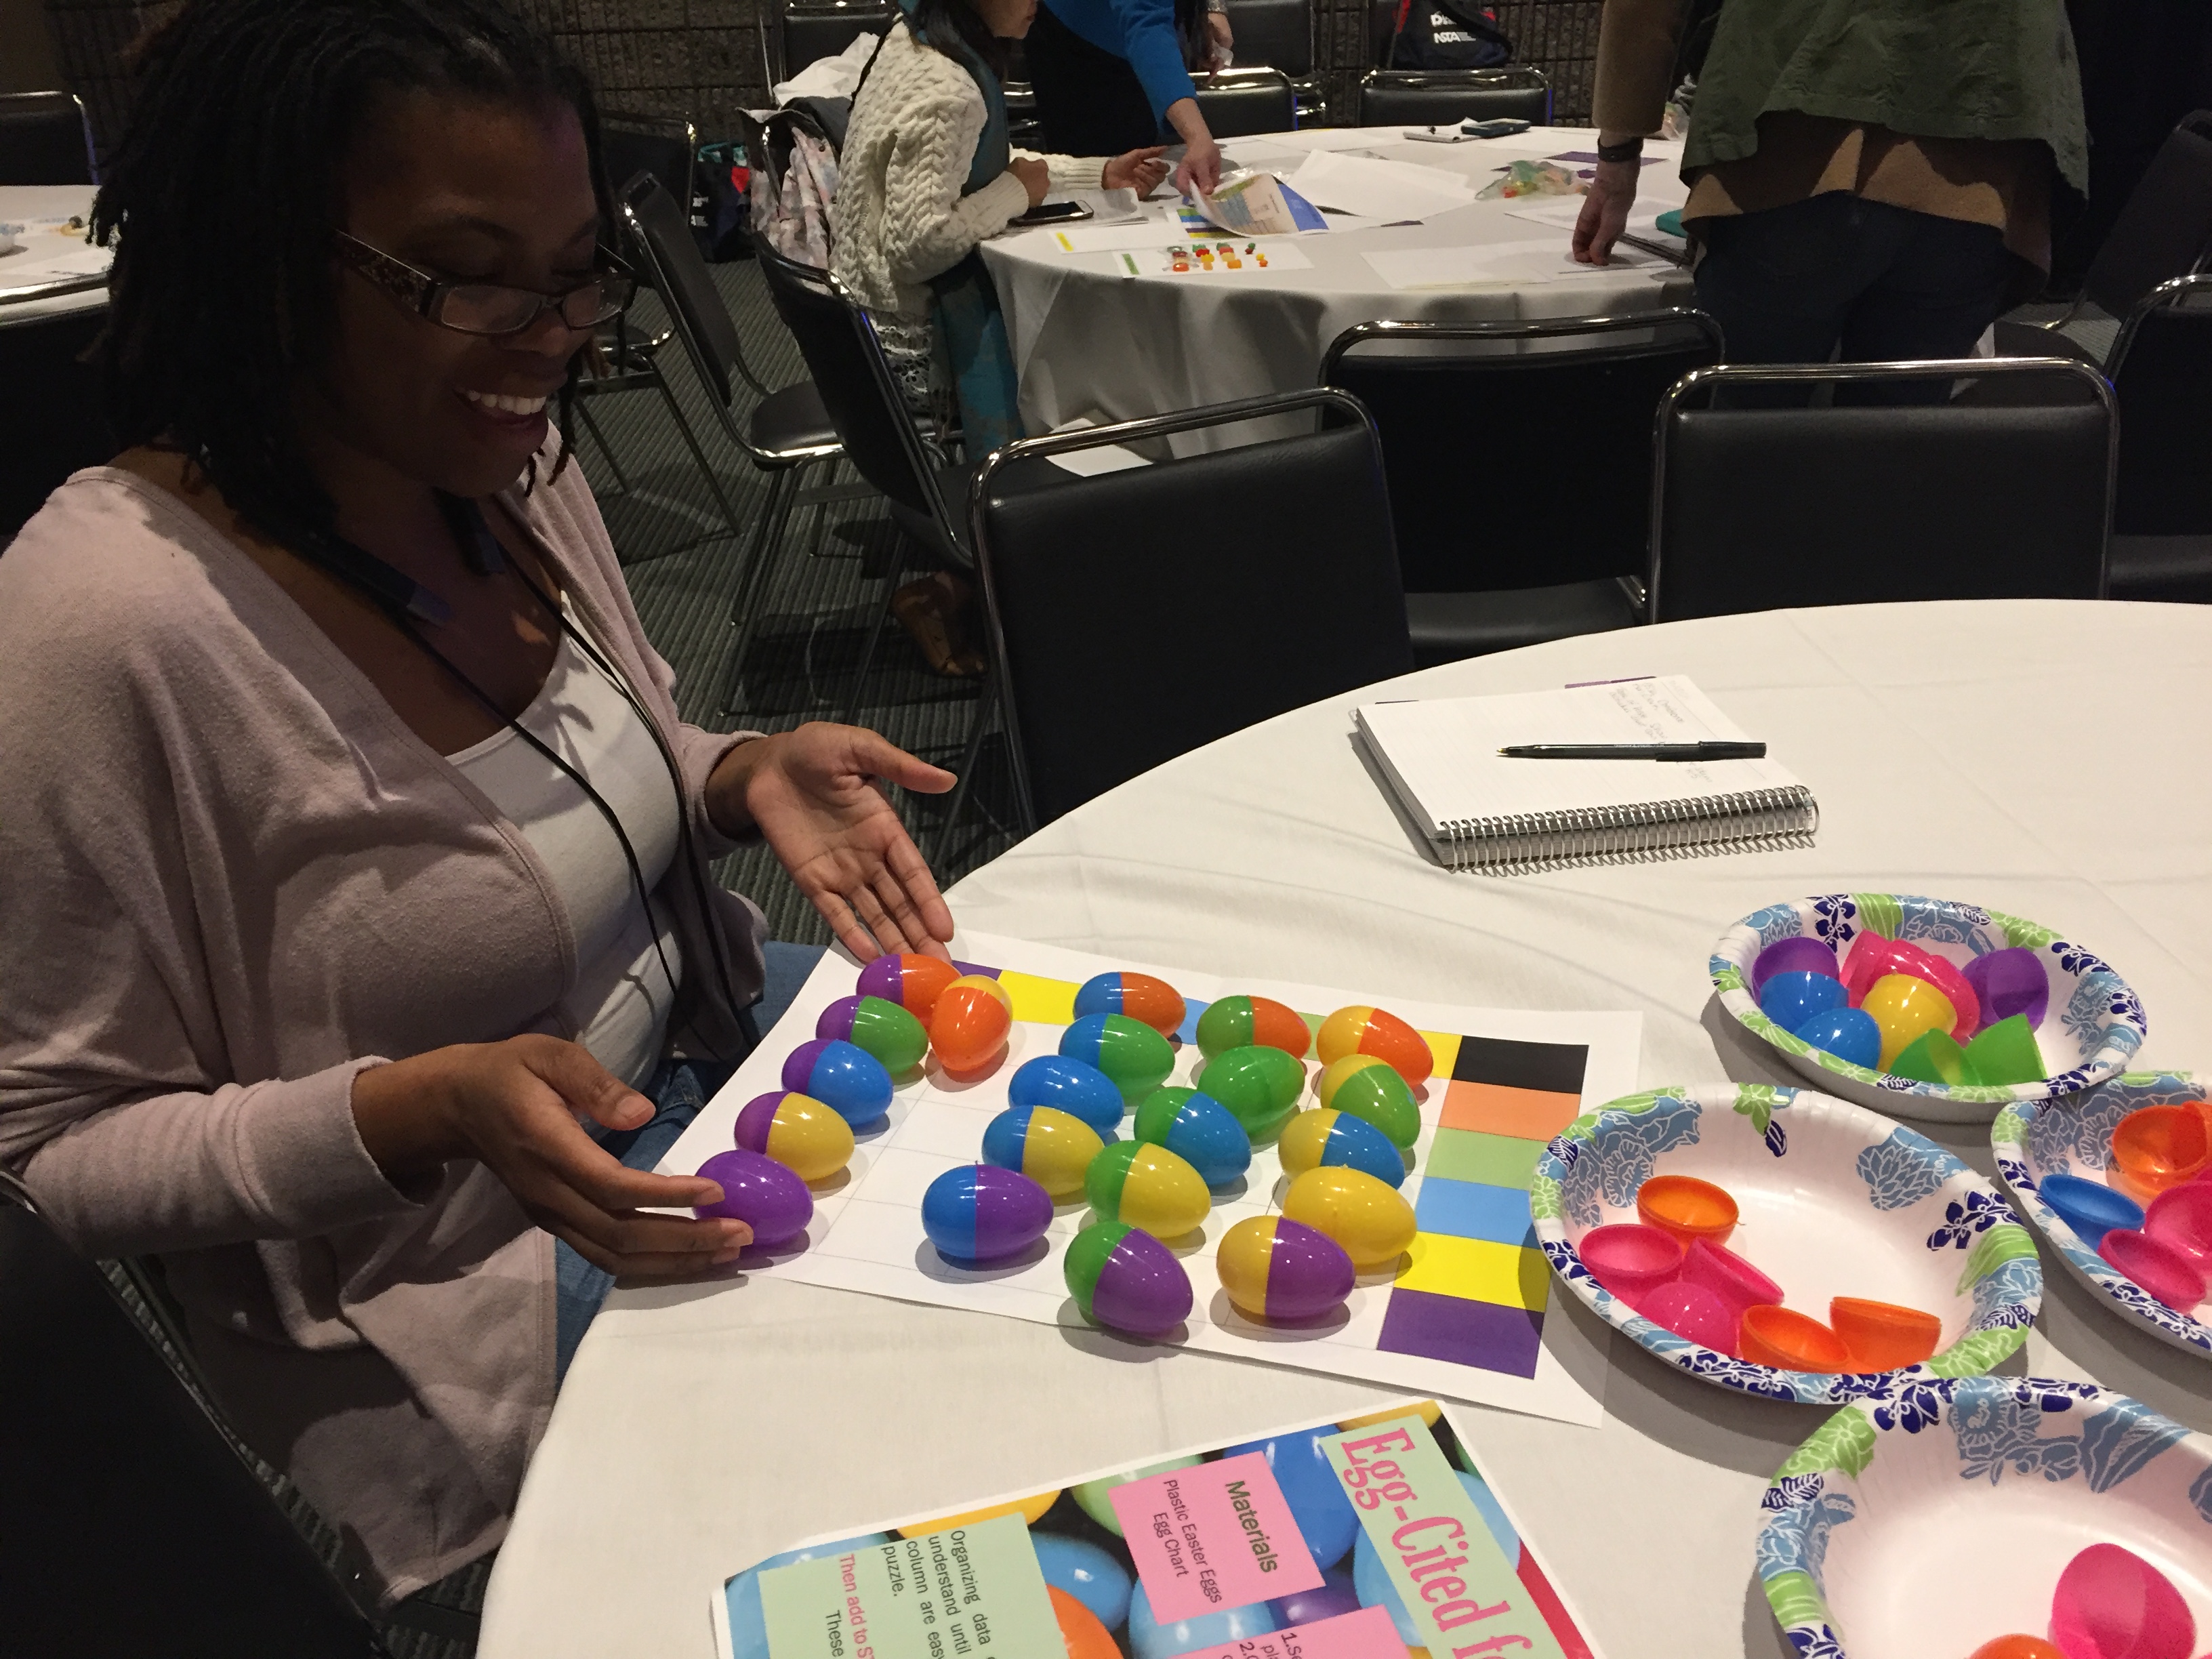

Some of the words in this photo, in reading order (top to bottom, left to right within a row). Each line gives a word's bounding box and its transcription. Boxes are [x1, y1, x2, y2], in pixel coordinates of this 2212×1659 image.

[1434, 32, 1461, 43] NSTA
[1153, 1512, 1173, 1538] Egg
[1164, 1538, 1189, 1578] Chart
[1163, 1479, 1189, 1521] Plastic
[1181, 1523, 1208, 1566] Easter
[1200, 1569, 1223, 1603] Eggs
[1225, 1480, 1279, 1573] Materials
[1340, 1427, 1511, 1633] Egg-Cited
[1452, 1635, 1534, 1659] f
[839, 1553, 857, 1592] Then
[881, 1545, 905, 1597] puzzle.
[906, 1540, 928, 1594] column
[920, 1601, 936, 1625] are
[928, 1536, 961, 1616] understand
[950, 1622, 972, 1655] until
[950, 1530, 981, 1605] Organizing
[972, 1613, 991, 1645] data
[825, 1610, 844, 1658] These
[846, 1596, 867, 1626] add
[853, 1628, 868, 1645] to
